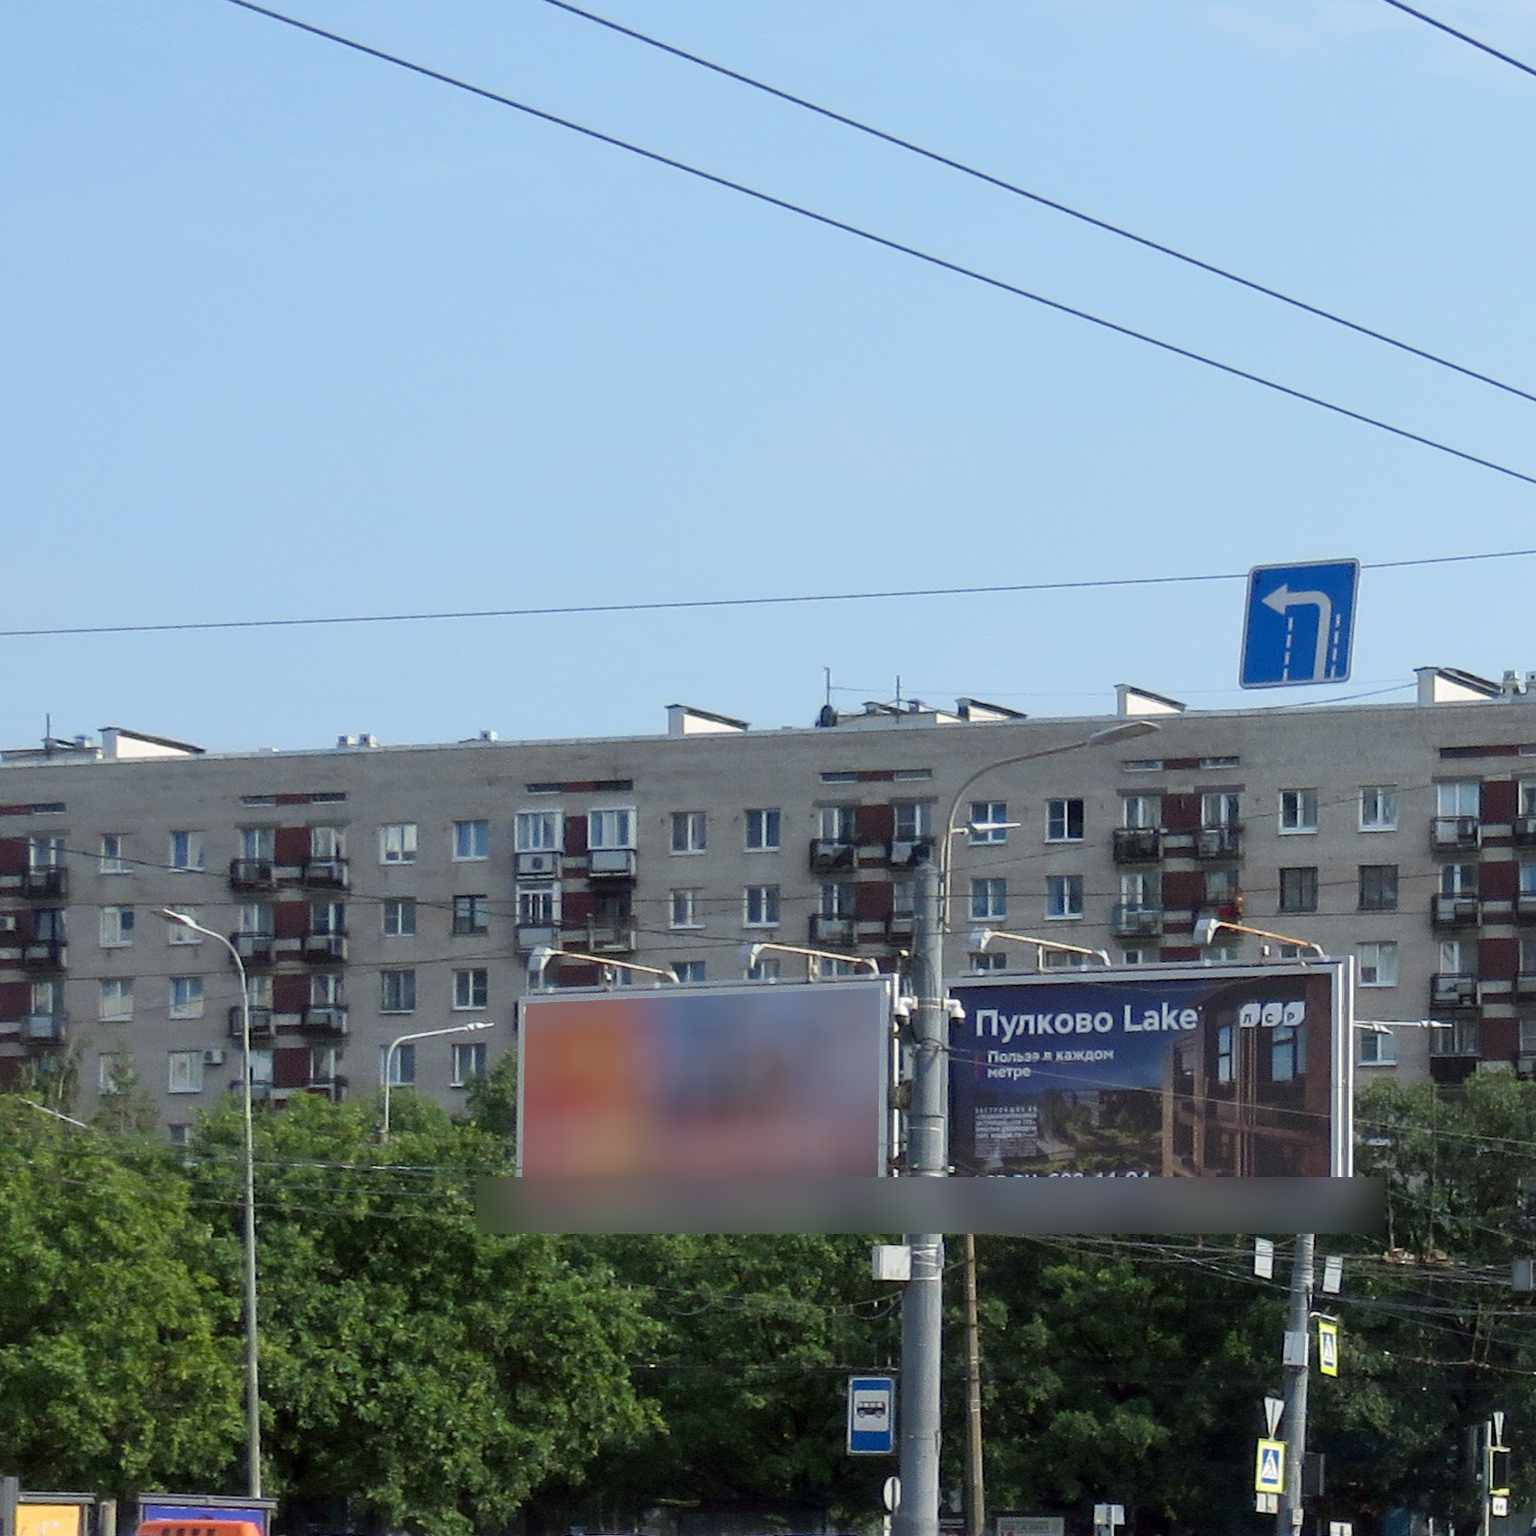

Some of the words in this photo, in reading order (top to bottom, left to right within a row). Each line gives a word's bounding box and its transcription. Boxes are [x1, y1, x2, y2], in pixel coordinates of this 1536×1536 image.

[976, 1009, 1114, 1043] Пулково
[987, 1051, 1040, 1064] Польза
[1055, 1048, 1114, 1062] каждом
[987, 1067, 1032, 1080] метре
